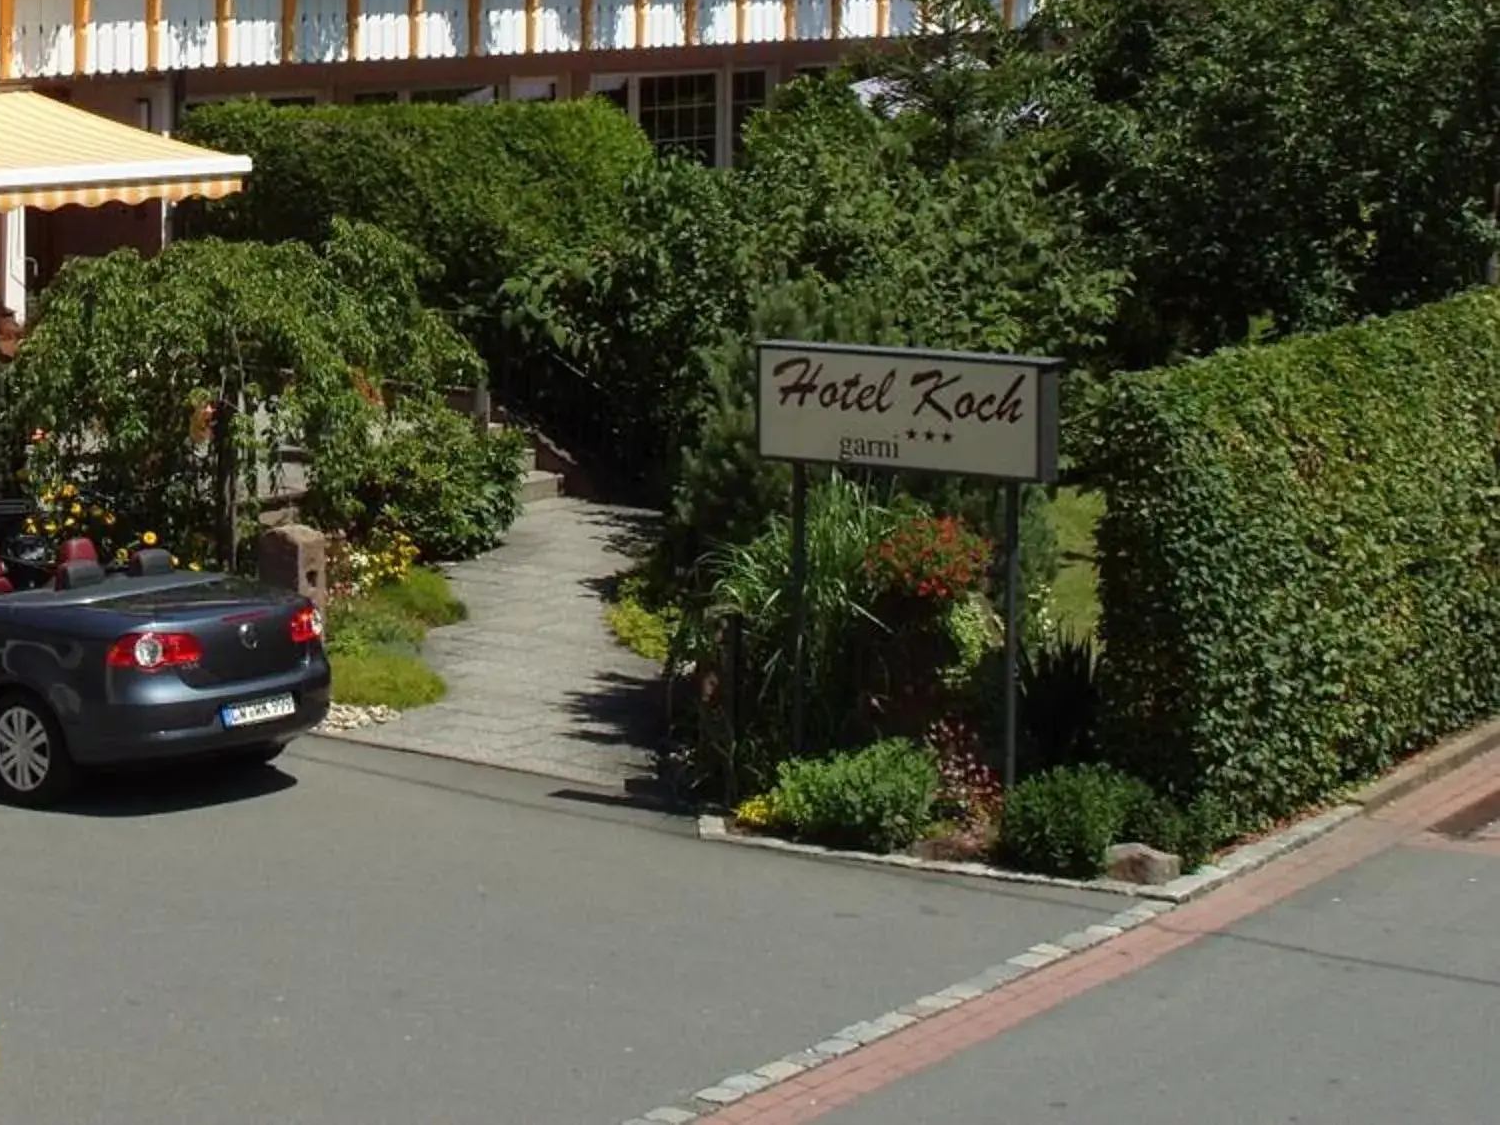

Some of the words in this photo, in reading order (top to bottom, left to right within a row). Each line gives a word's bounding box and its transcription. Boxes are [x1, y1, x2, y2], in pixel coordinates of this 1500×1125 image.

[773, 357, 897, 413] Hotel
[910, 369, 1026, 424] Koch
[839, 434, 900, 461] garni
